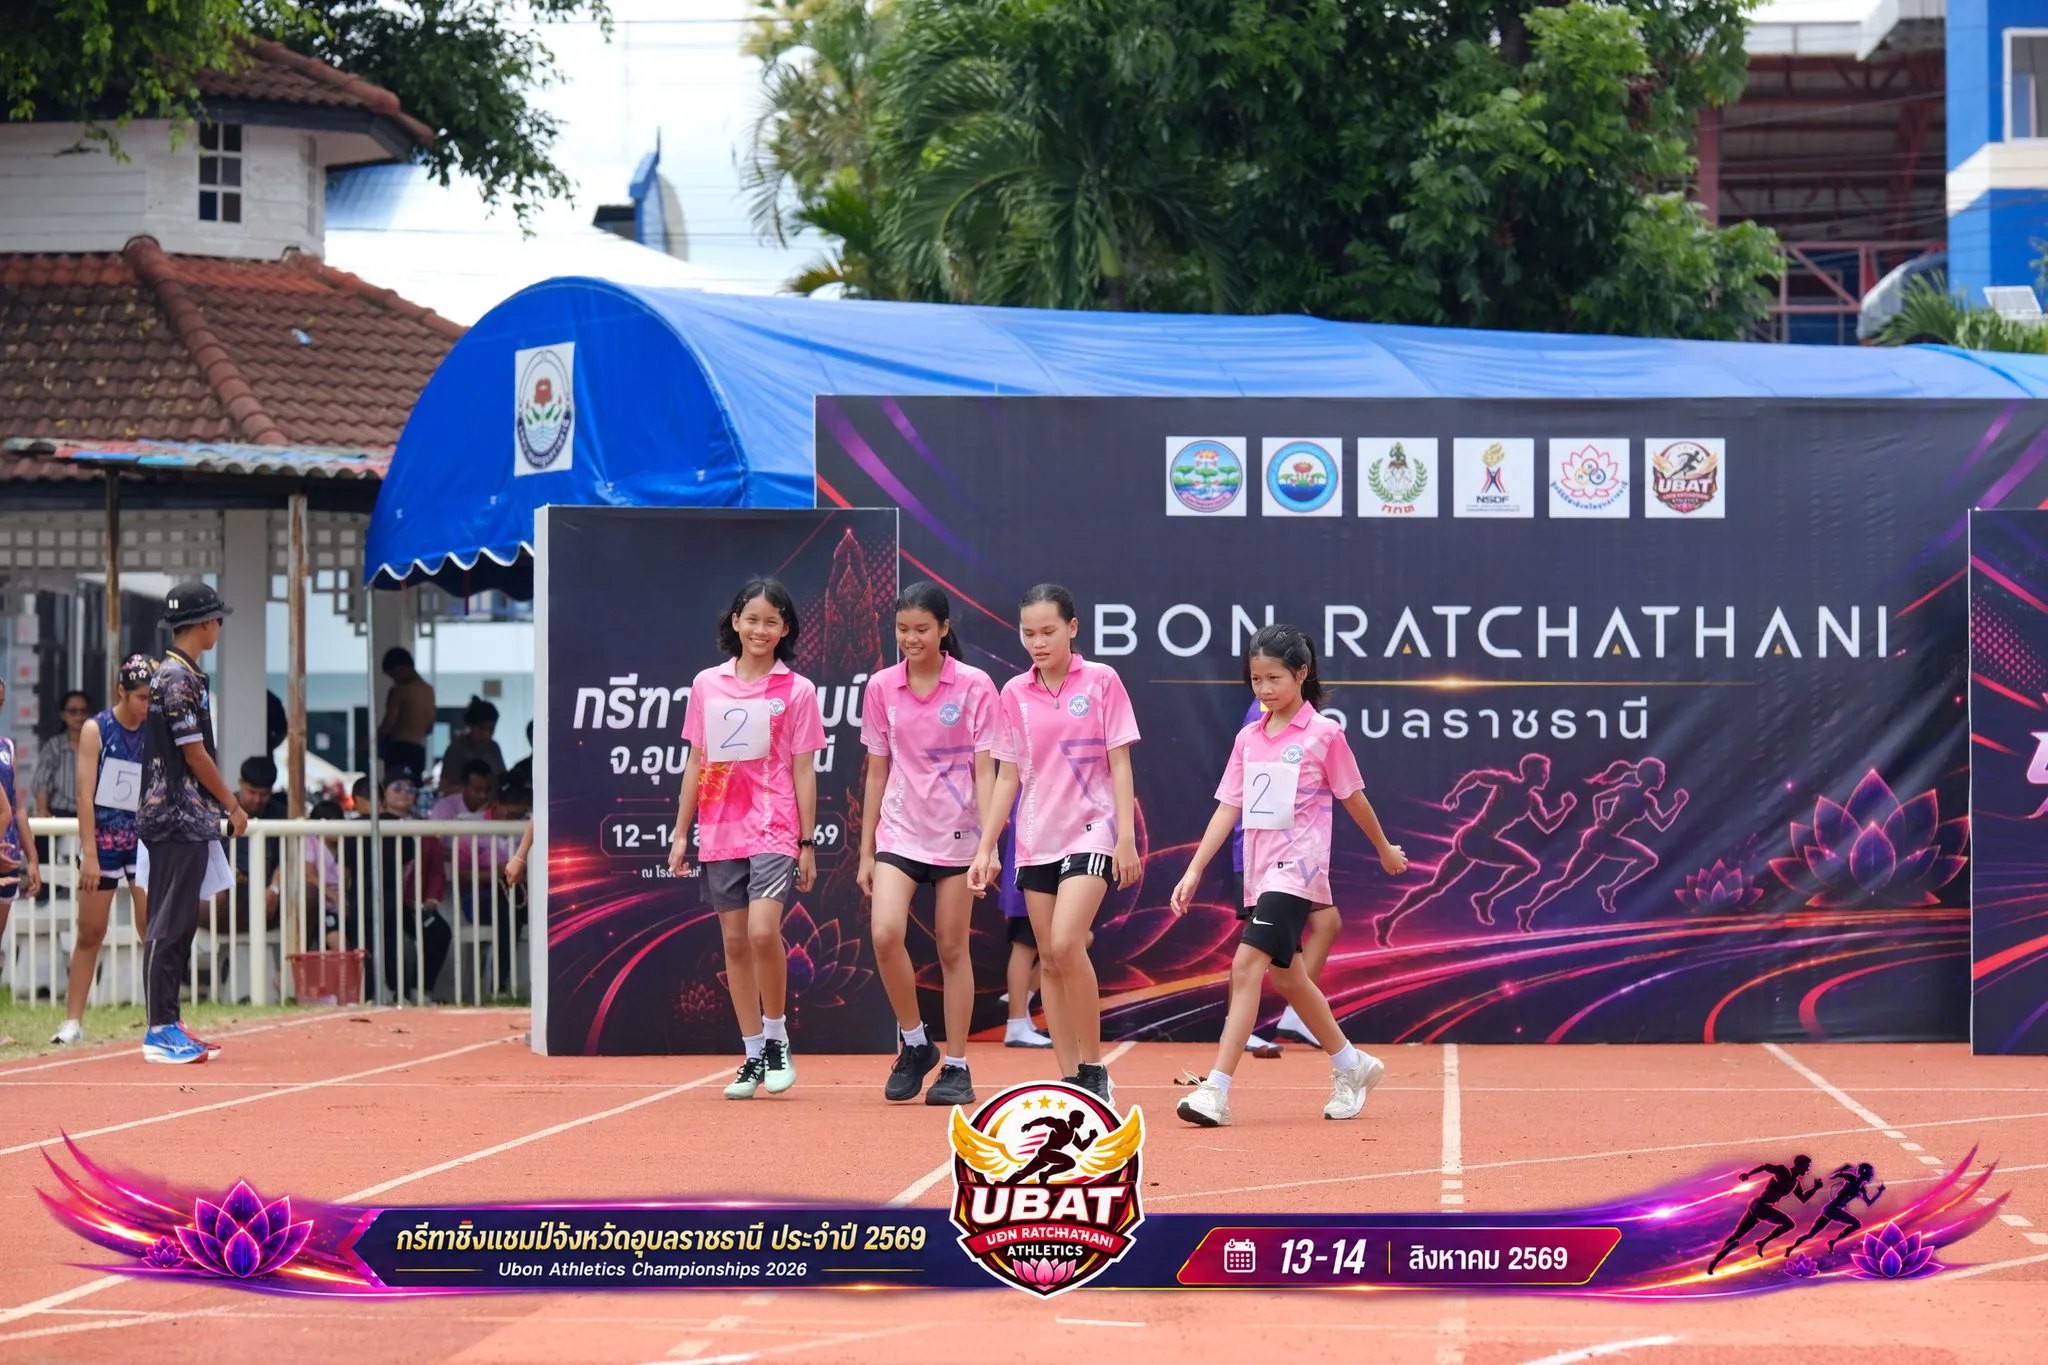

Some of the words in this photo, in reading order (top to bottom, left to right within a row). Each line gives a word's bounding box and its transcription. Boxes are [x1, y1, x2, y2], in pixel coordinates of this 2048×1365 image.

[1658, 478, 1713, 494] UBAT
[1094, 603, 1275, 658] BON
[1324, 604, 1889, 660] RATCHATHANI
[719, 707, 750, 750] 2
[113, 770, 138, 802] 5
[1249, 772, 1275, 814] 2
